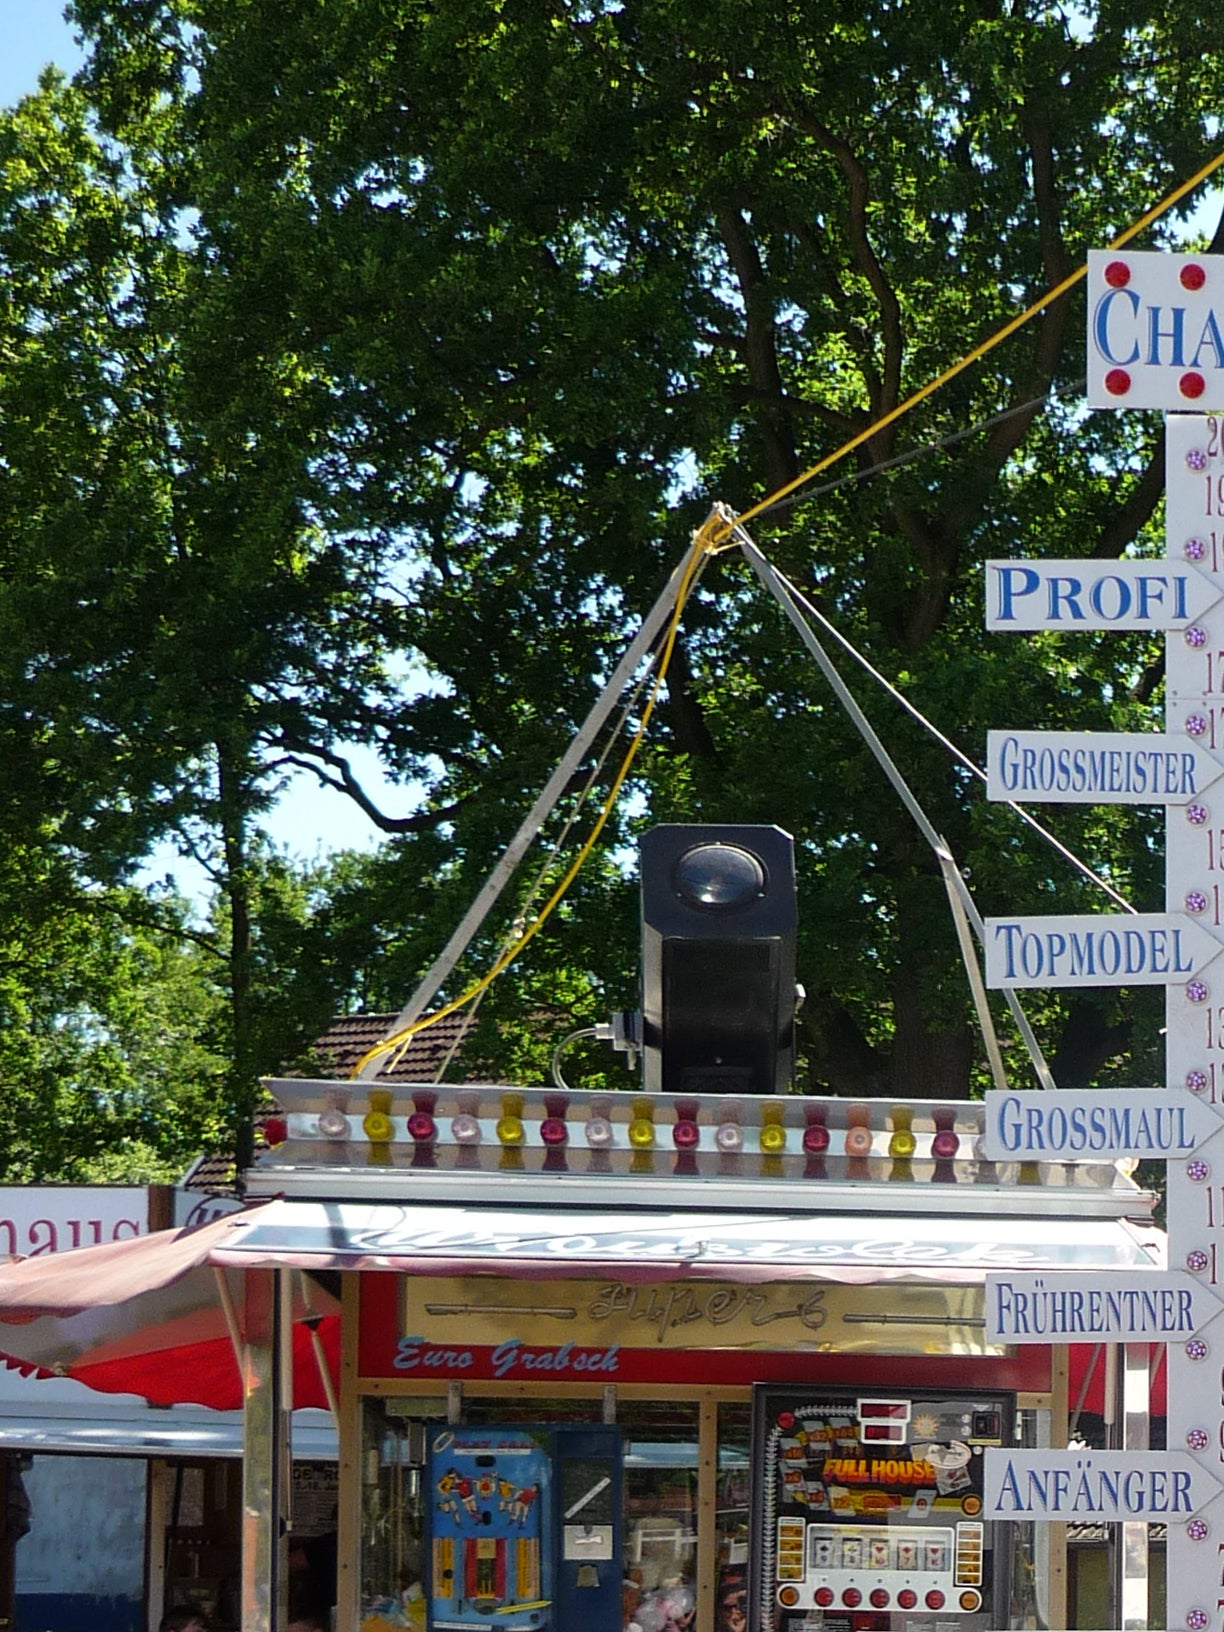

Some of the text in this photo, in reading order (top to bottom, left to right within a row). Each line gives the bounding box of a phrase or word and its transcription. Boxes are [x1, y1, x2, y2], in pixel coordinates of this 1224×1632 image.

[997, 568, 1187, 620] PROFI
[1000, 737, 1195, 794] GROSSMEISTER
[996, 925, 1192, 978] TOPMODEL
[998, 1098, 1195, 1151] GROSSMAUL
[997, 1280, 1193, 1334] FRÜHRENTNER
[394, 1336, 622, 1376] Euro Grabsch
[824, 1459, 937, 1484] FULL HOUSE
[996, 1461, 1192, 1512] ANFÄNGER
